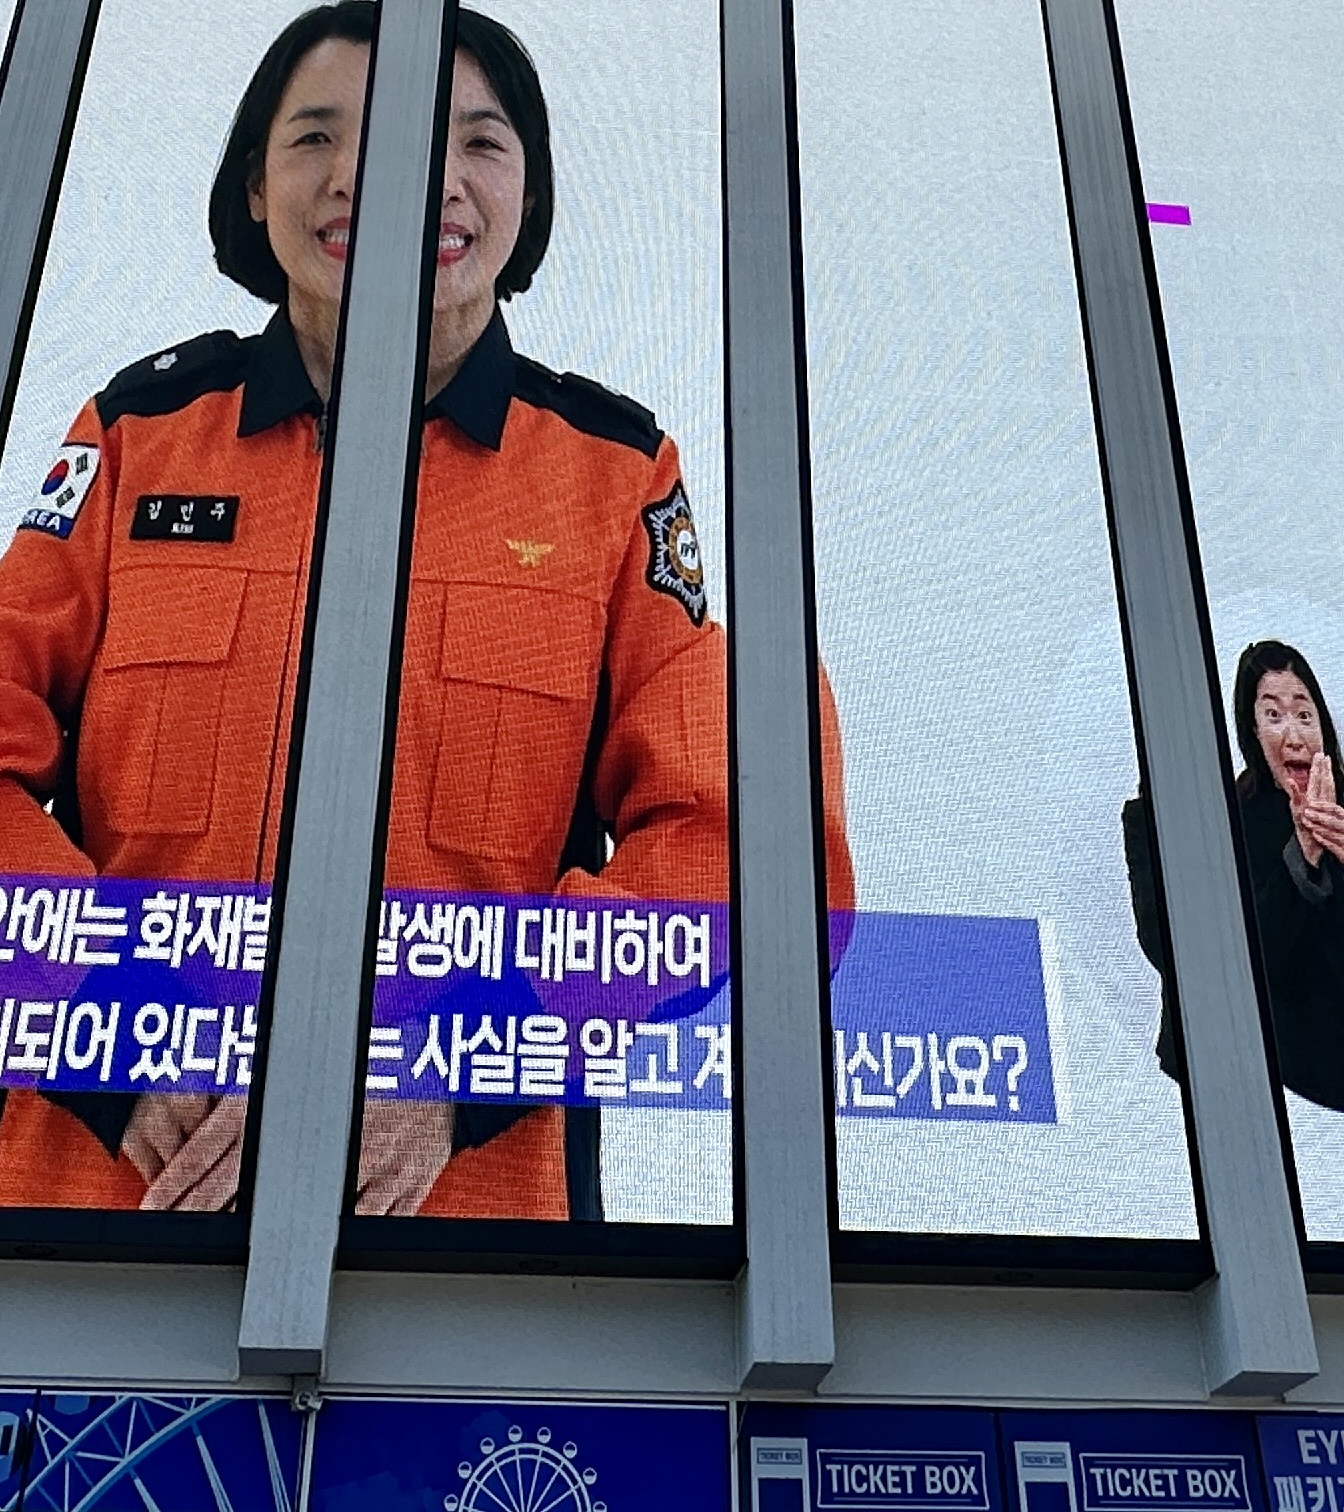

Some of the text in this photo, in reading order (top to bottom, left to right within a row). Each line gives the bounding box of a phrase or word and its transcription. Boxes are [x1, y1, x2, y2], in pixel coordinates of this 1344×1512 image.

[515, 908, 710, 988] 대비하여
[411, 1013, 570, 1096] 사실을
[579, 1019, 683, 1098] 알고
[825, 1463, 979, 1495] TICKET BOX
[1089, 1467, 1242, 1498] TICKET BOX
